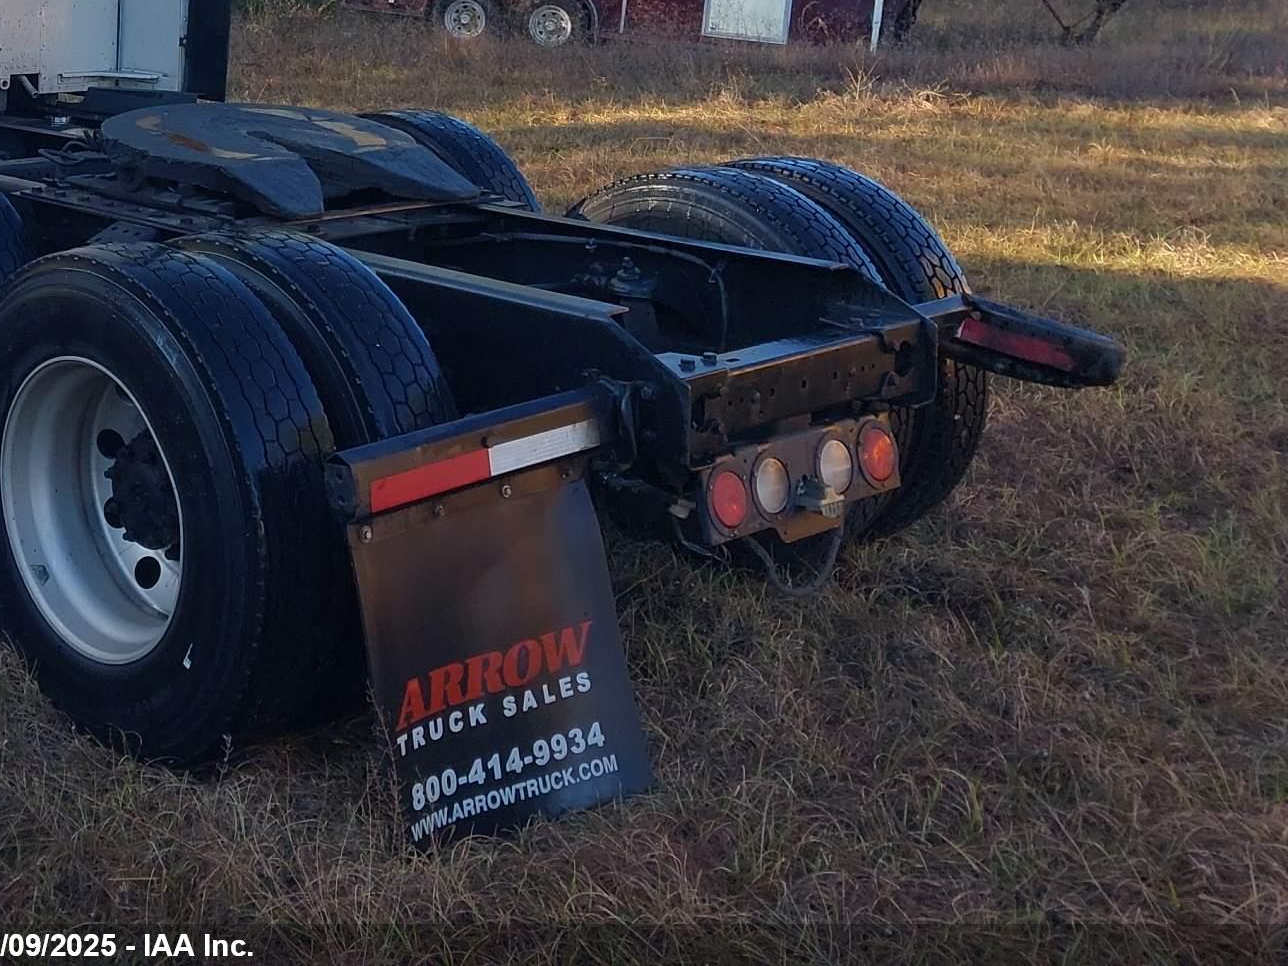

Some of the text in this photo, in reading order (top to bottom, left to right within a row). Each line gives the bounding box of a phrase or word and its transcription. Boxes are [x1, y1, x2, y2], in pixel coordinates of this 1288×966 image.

[396, 618, 592, 731] ARROW
[397, 672, 592, 756] TRUCK SALES
[411, 721, 605, 811] 800-414-9934
[411, 754, 619, 842] WWW.ARROWTRUCK.COM
